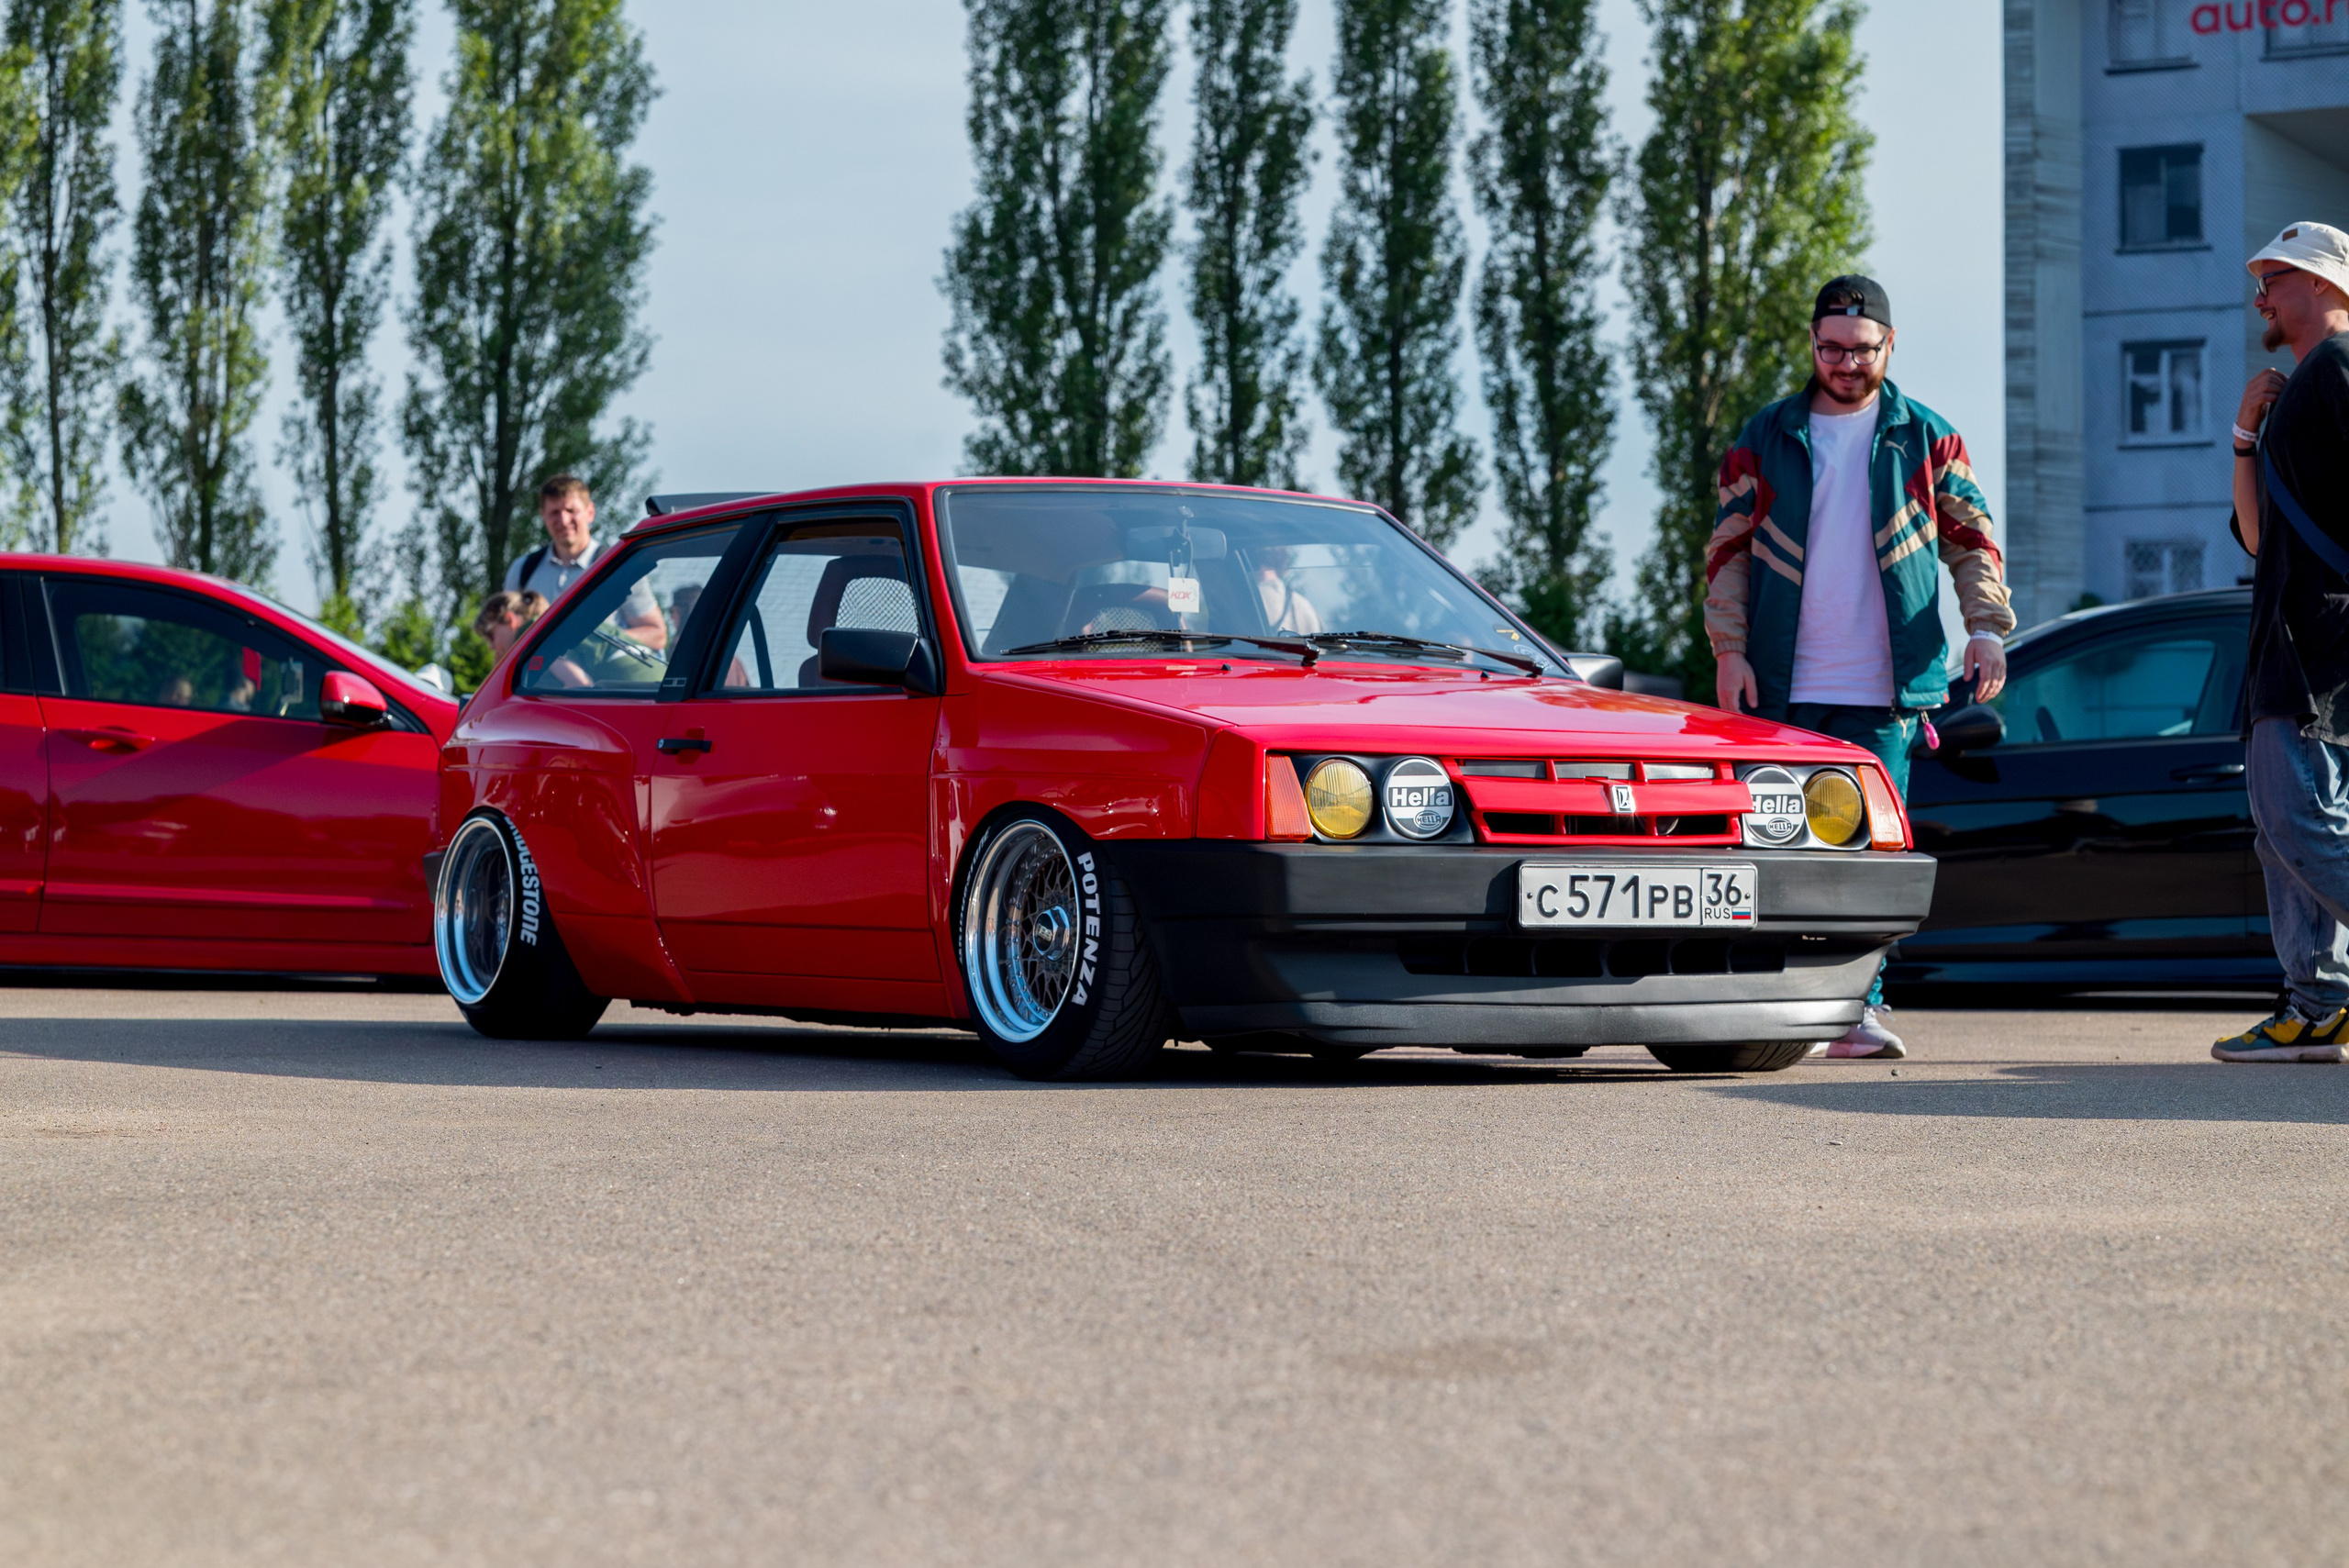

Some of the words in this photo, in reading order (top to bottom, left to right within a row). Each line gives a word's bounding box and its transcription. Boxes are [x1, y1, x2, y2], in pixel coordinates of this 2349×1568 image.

[2190, 0, 2349, 35] auto.r
[1392, 787, 1450, 806] Hella
[504, 816, 540, 947] IDGESTONE
[1706, 873, 1742, 906] 36
[1071, 851, 1101, 1006] POTENZA
[1704, 906, 1731, 920] RUS
